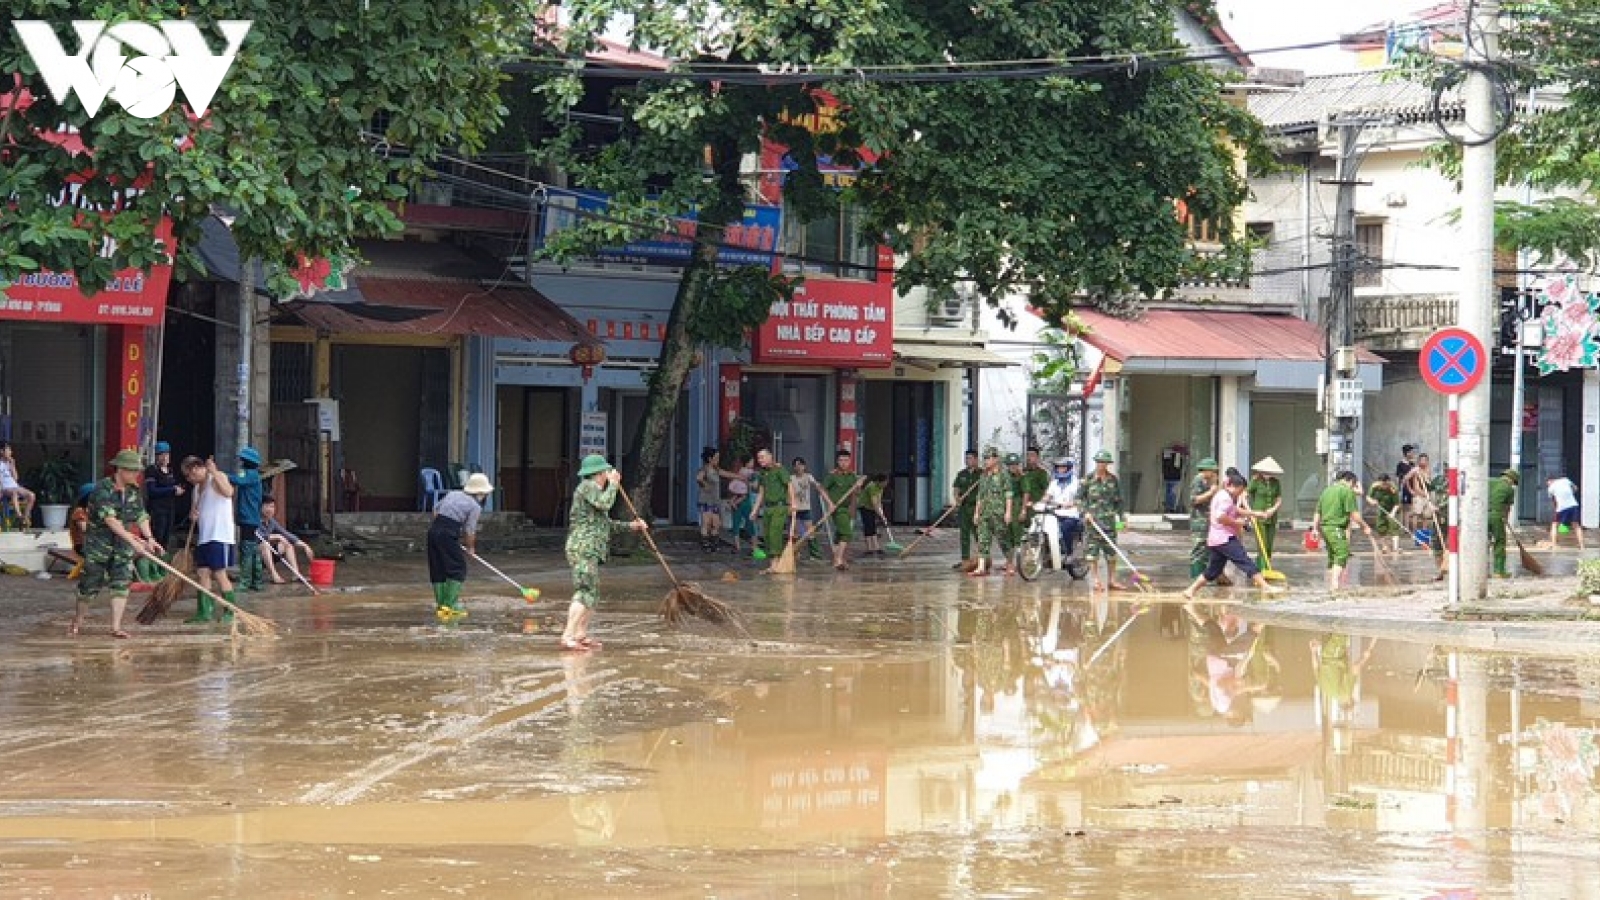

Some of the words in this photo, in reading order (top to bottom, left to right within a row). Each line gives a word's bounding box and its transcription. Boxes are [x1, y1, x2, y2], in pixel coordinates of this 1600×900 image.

[769, 297, 789, 319] NỘI
[792, 297, 819, 319] THẤT
[823, 301, 859, 321] PHÒNG
[777, 322, 801, 341] NHÀ
[804, 321, 825, 342] BẾP
[829, 326, 851, 343] CAO
[855, 324, 877, 345] CẤP
